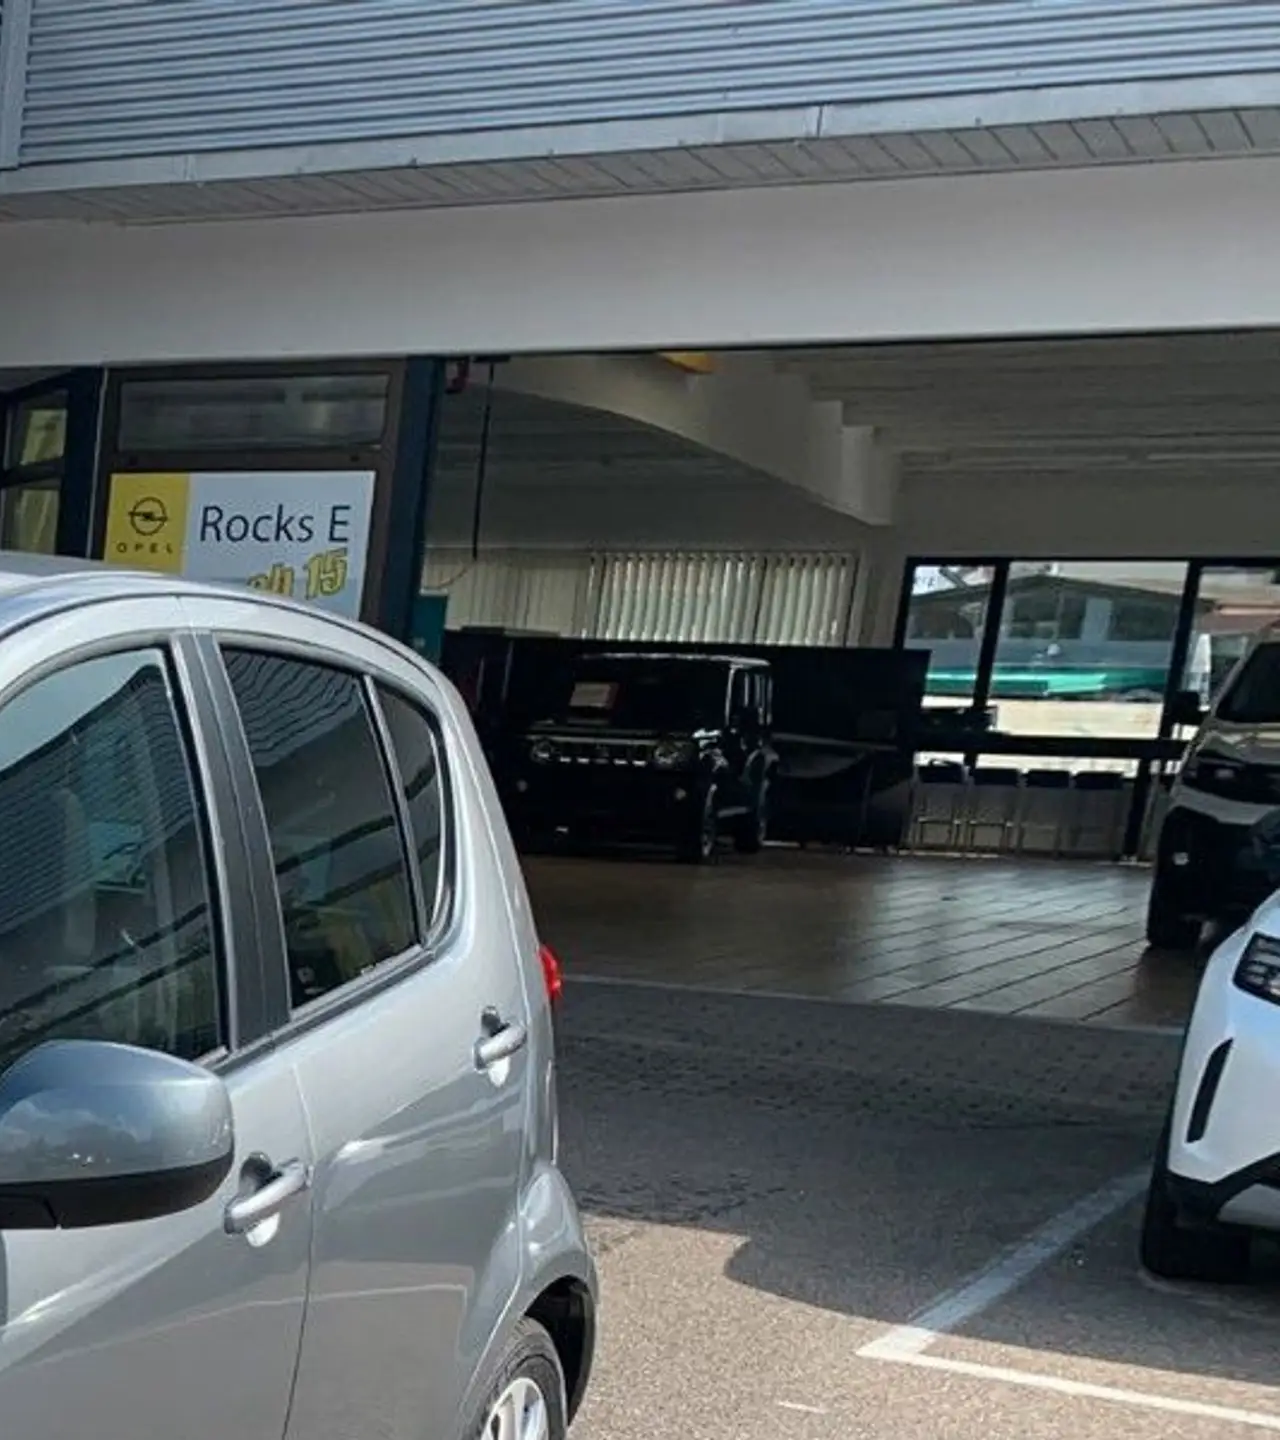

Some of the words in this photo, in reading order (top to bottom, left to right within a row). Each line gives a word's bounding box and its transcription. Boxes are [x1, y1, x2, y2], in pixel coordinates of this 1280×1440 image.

[199, 504, 315, 543] Rocks
[328, 505, 352, 543] E
[116, 541, 174, 554] OPEL
[303, 547, 349, 600] 15
